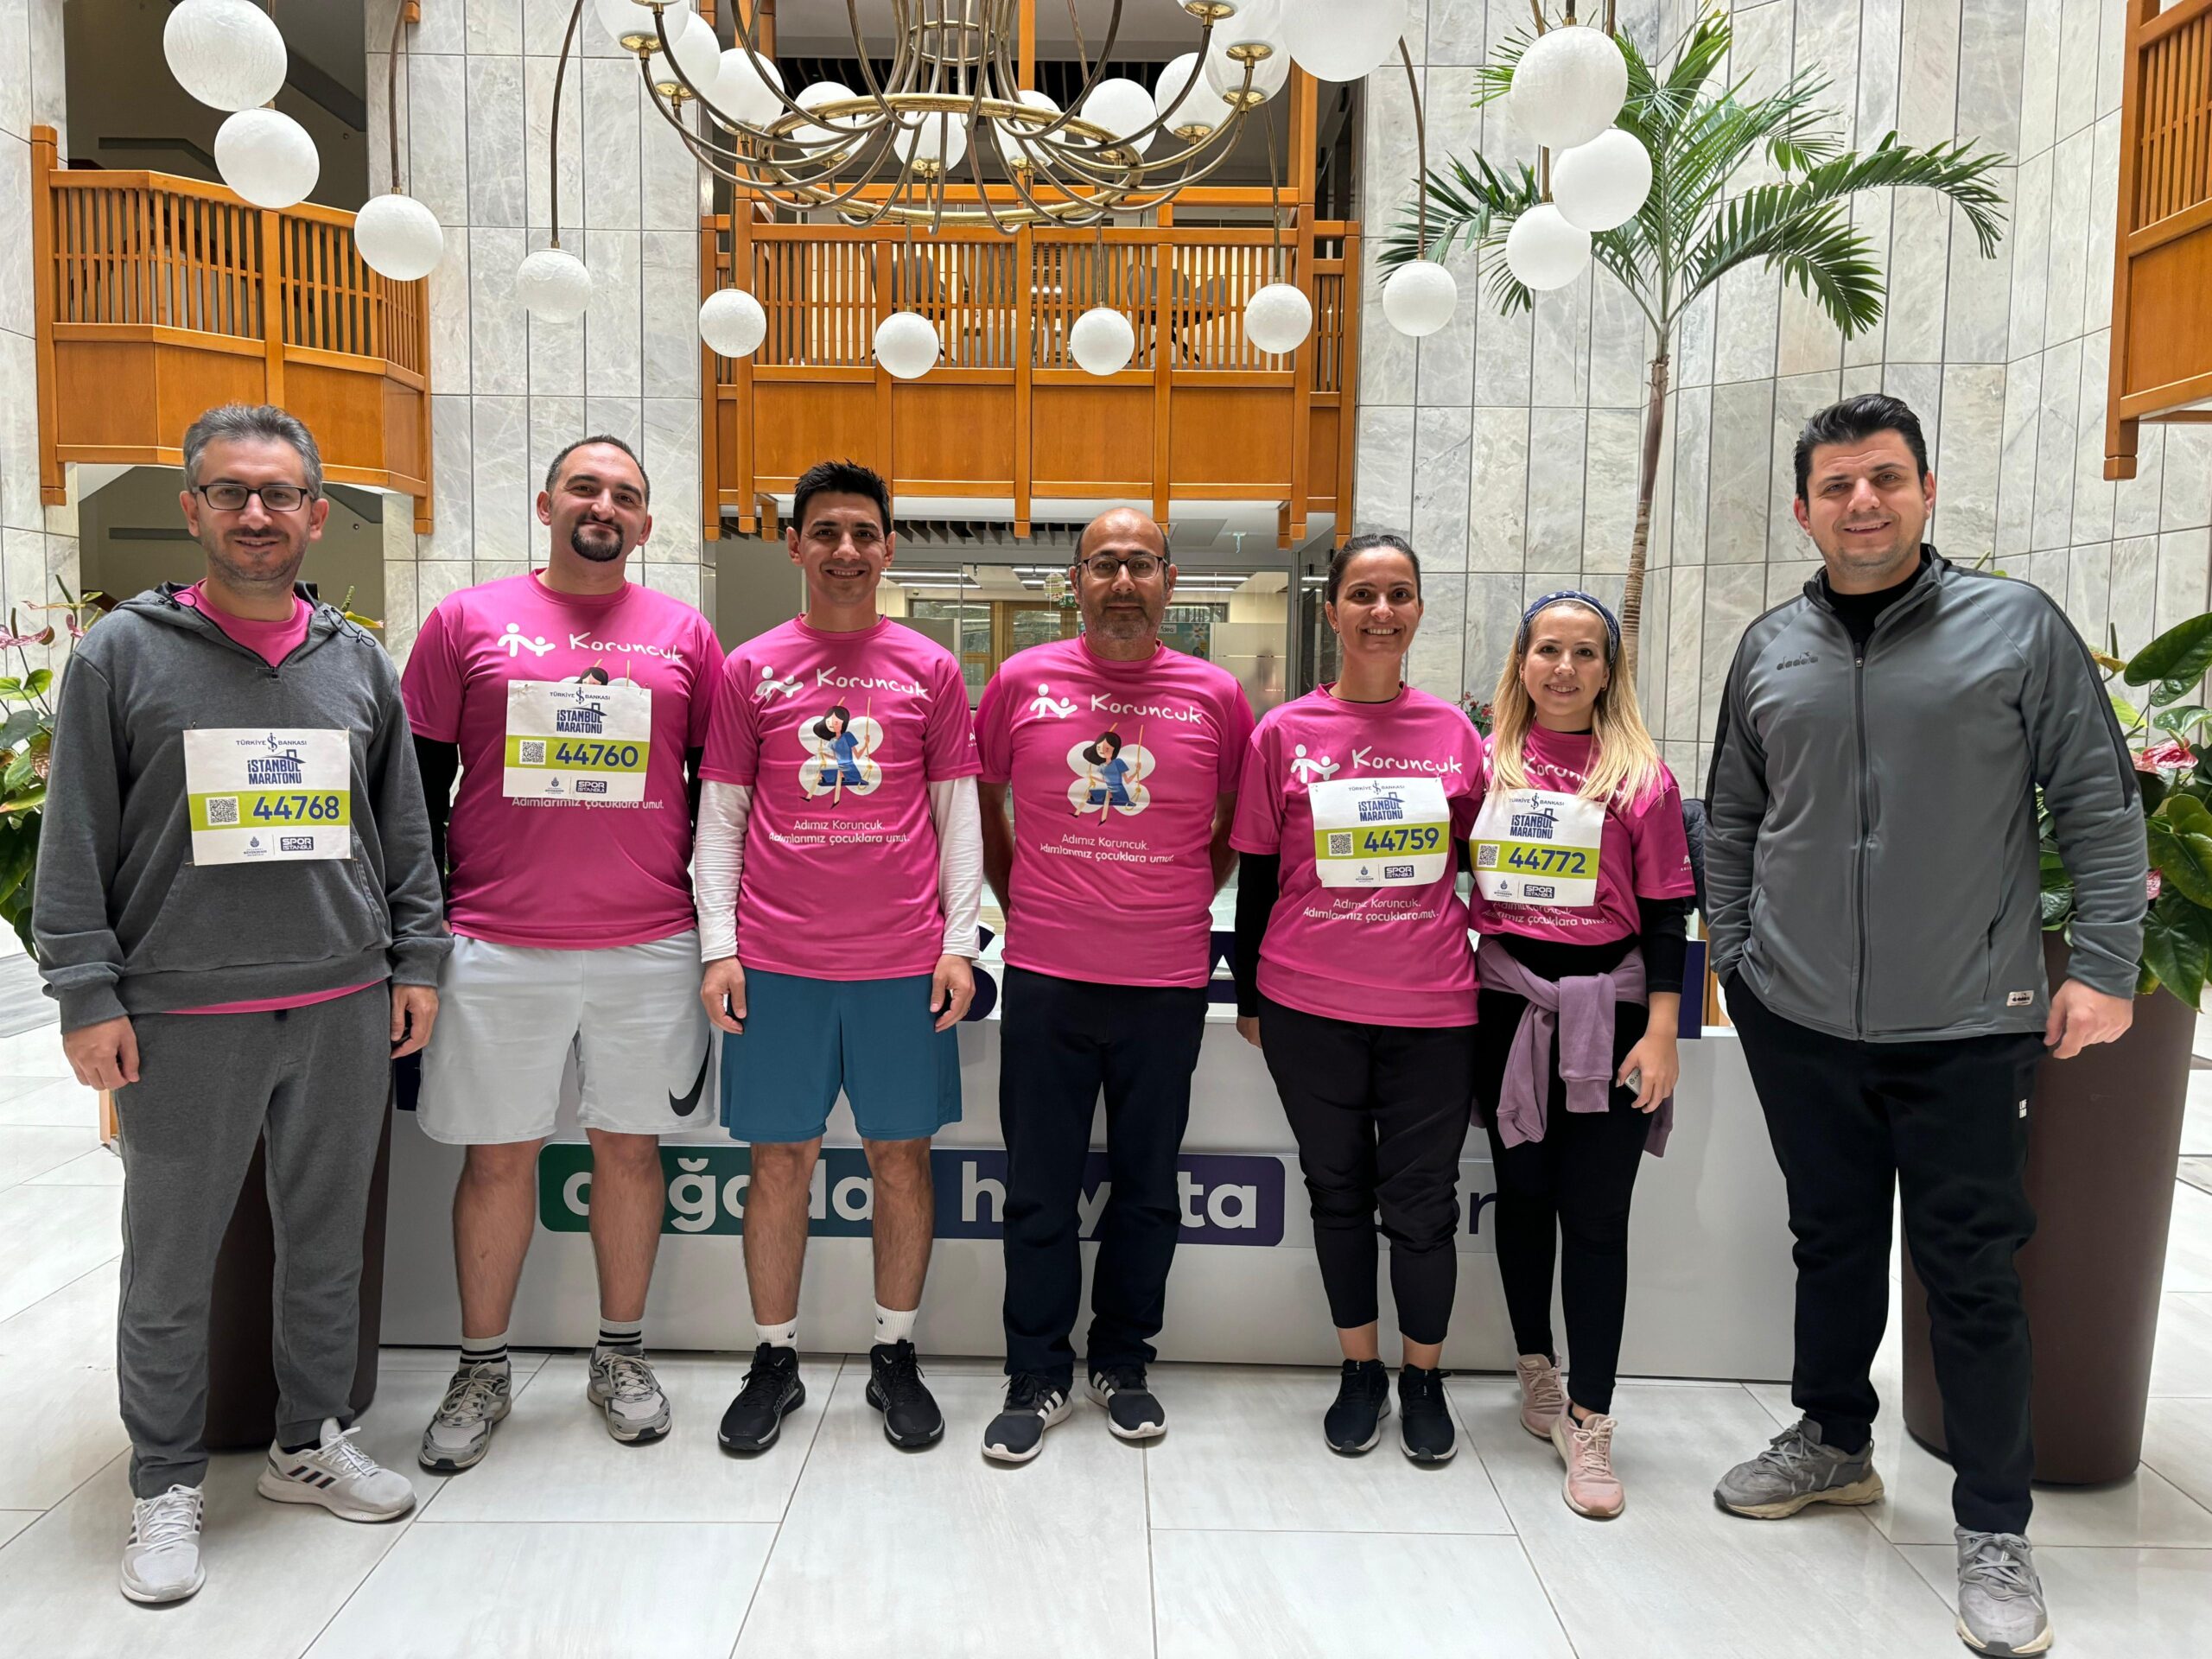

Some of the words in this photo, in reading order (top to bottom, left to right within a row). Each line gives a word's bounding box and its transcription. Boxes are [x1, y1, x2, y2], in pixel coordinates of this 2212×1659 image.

[569, 632, 683, 663] Koruncuk
[816, 666, 933, 702] Koruncuk
[1090, 693, 1203, 724] Koruncuk
[556, 721, 602, 734] MARATONU
[556, 743, 639, 767] 44760
[1351, 746, 1462, 774] Koruncuk
[249, 772, 302, 785] MARATONU
[252, 796, 340, 820] 44768
[1360, 810, 1403, 822] MARATONU
[793, 820, 829, 830] Adımız
[833, 820, 885, 830] Koruncuk.
[830, 833, 883, 845] çocuklara
[1363, 827, 1440, 852] 44759
[1510, 827, 1553, 839] MARATONU
[1062, 834, 1095, 846] Adımız
[1098, 836, 1150, 850] Koruncuk.
[1095, 851, 1146, 862] çocuklara
[1509, 848, 1586, 874] 44772
[1370, 899, 1421, 908] Koruncuk.
[1365, 911, 1418, 923] çocuklara
